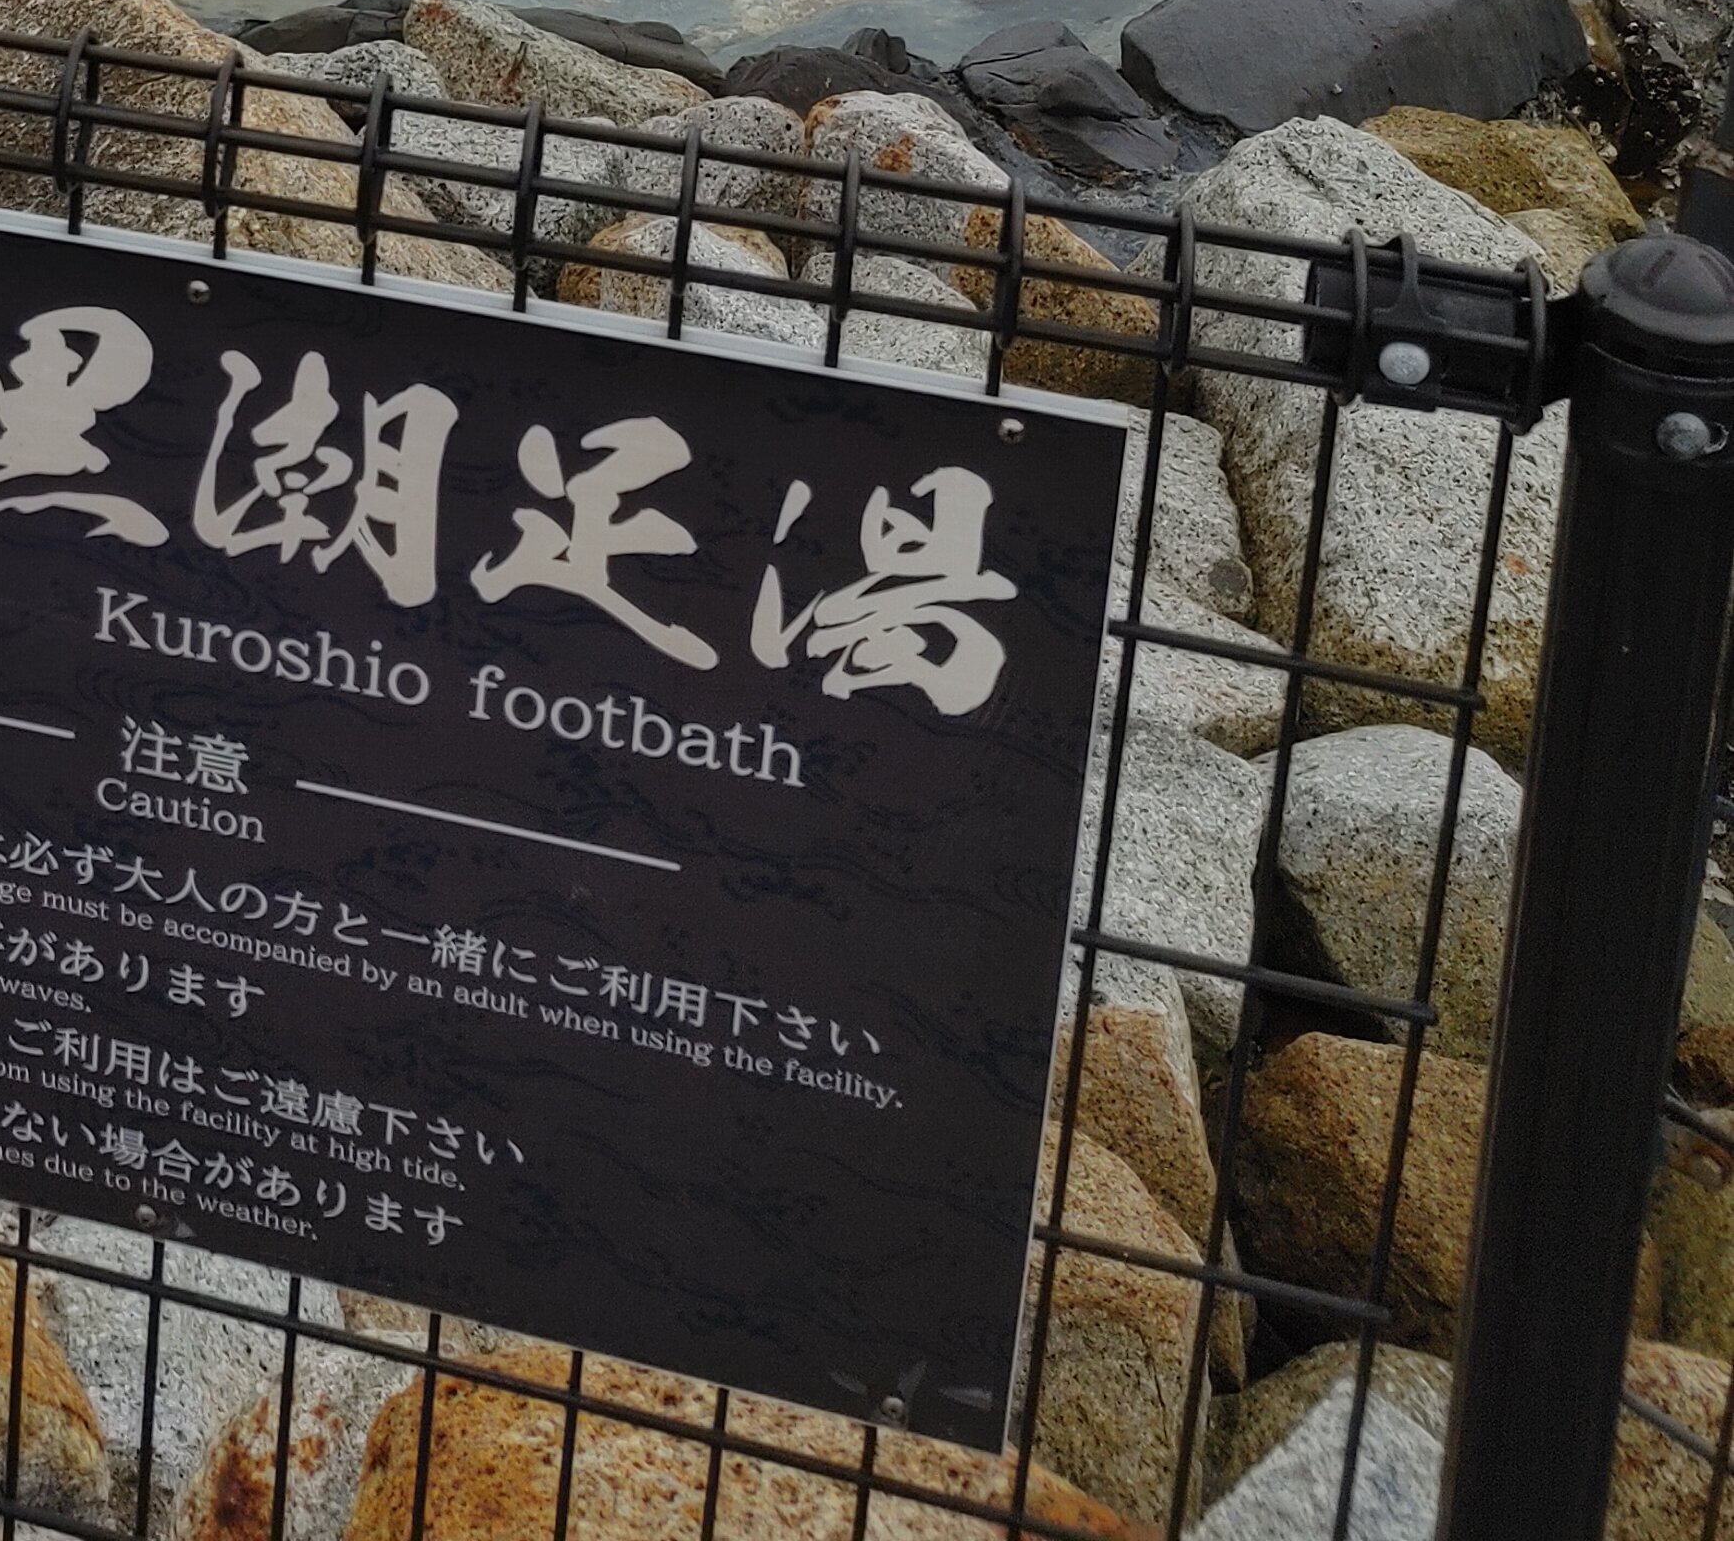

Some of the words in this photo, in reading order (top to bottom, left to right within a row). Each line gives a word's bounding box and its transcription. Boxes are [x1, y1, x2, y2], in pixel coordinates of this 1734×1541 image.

[93, 586, 431, 706] Kuroshio
[468, 664, 806, 788] footbath
[120, 715, 250, 795] 注意
[96, 777, 266, 843] Caution
[42, 890, 110, 921] must
[120, 902, 154, 931] be
[163, 918, 351, 977] accompanied
[361, 958, 398, 991] by
[407, 974, 443, 999] an
[453, 985, 529, 1019] adult
[539, 1004, 620, 1040] when
[631, 1026, 714, 1067] using
[723, 1045, 773, 1076] the
[785, 1057, 903, 1109] facility.
[41, 1070, 117, 1108] using
[124, 1088, 170, 1117] the
[181, 1100, 281, 1148] facility
[290, 1132, 319, 1154] at
[329, 1136, 392, 1173] high
[402, 1156, 466, 1192] tide.
[44, 1153, 94, 1182] due
[104, 1167, 131, 1191] to
[142, 1176, 186, 1205] the
[196, 1193, 318, 1241] weather.
